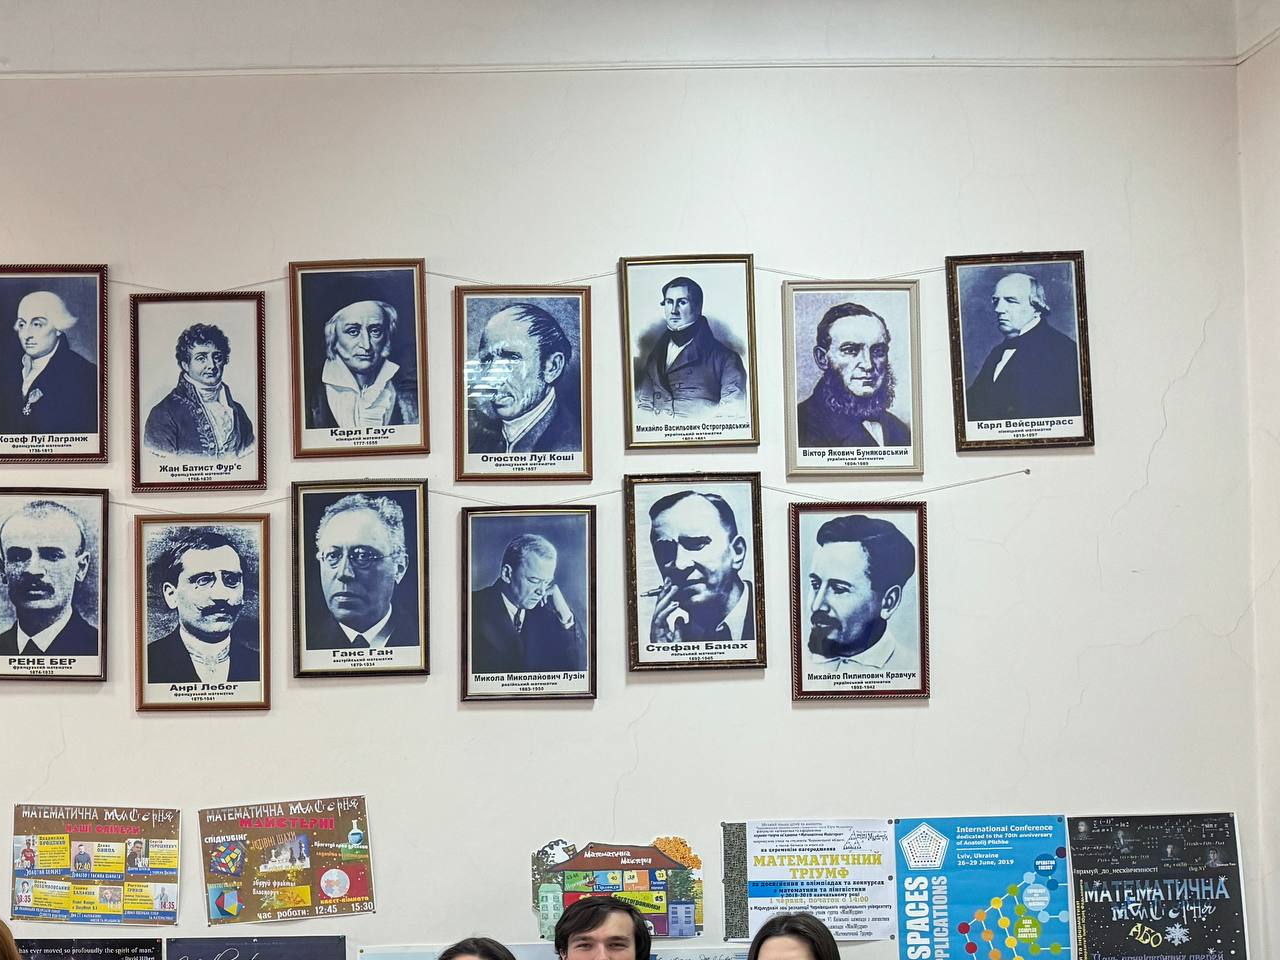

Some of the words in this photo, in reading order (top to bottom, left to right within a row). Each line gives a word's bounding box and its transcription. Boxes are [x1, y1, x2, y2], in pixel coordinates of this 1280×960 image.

[664, 424, 700, 432] Васильович
[701, 423, 749, 432] Остроградський
[977, 421, 1002, 430] Карл
[329, 428, 361, 437] Карл
[365, 427, 396, 436] Гаус
[30, 435, 46, 444] Луї
[48, 435, 88, 444] Лагранж
[529, 454, 547, 462] Луї
[549, 453, 574, 461] Коші
[802, 449, 826, 457] Віктор
[828, 449, 855, 457] Якович
[856, 448, 908, 457] Буняковський
[160, 465, 180, 473] Жан
[181, 464, 215, 472] Батист
[646, 643, 700, 653] Стефан
[704, 641, 748, 651] Банах
[332, 650, 365, 658] Ганс
[368, 648, 393, 656] Ган
[8, 658, 46, 666] РЕНЕ
[49, 657, 77, 666] БЕР
[474, 673, 504, 682] Микола
[506, 672, 560, 681] Миколайович
[562, 672, 585, 681] Лузін
[807, 672, 840, 680] Михайло
[842, 672, 884, 680] Пилипович
[886, 671, 917, 680] Кравчук
[170, 684, 197, 692] Анрі
[201, 683, 239, 691] Лебег
[22, 806, 99, 820] МАТЕМАТИЧНА
[206, 803, 285, 822] МАТЕМАТИЧНА
[956, 825, 1008, 833] International
[753, 851, 882, 867] МАТЕМАТИЧНИЙ
[790, 867, 849, 880] ТРІУМФ
[1084, 878, 1231, 903] МАТЕМАТИЧНА
[257, 911, 272, 920] час
[315, 905, 338, 915] 12:45
[351, 902, 373, 912] 15:30
[904, 876, 931, 960] SPACES
[1129, 923, 1163, 948] АБО
[72, 947, 103, 955] profoundly
[115, 947, 130, 955] spirit
